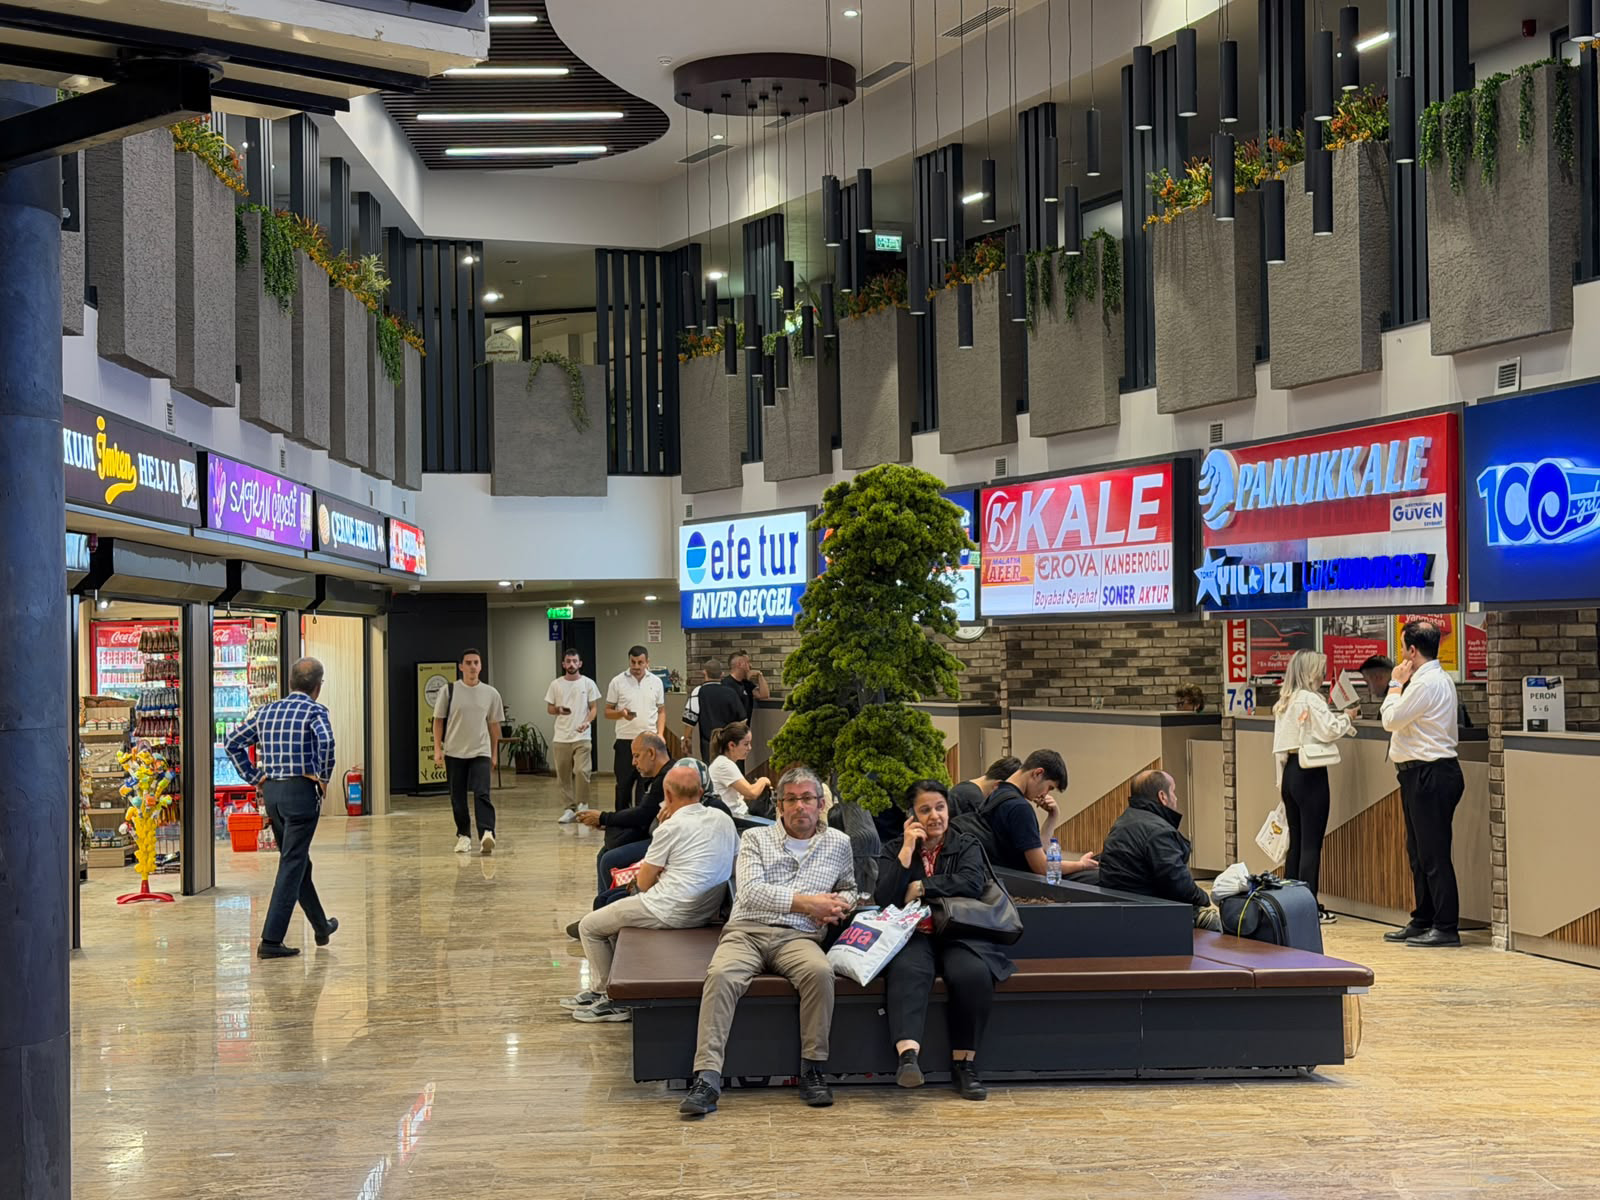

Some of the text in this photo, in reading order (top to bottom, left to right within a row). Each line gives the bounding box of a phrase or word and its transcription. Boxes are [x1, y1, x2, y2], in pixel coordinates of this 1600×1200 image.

[138, 453, 179, 494] HELVA
[1234, 436, 1431, 512] PAMUKKALE
[1016, 473, 1164, 551] KALE
[711, 524, 799, 581] efe tur
[1102, 585, 1170, 606] SONER AKTUR
[1217, 561, 1293, 596] YILDIZI
[691, 587, 794, 624] ENVER GEÇGEL
[1035, 588, 1098, 609] Boyabat Seyahat
[1530, 692, 1557, 700] PERON
